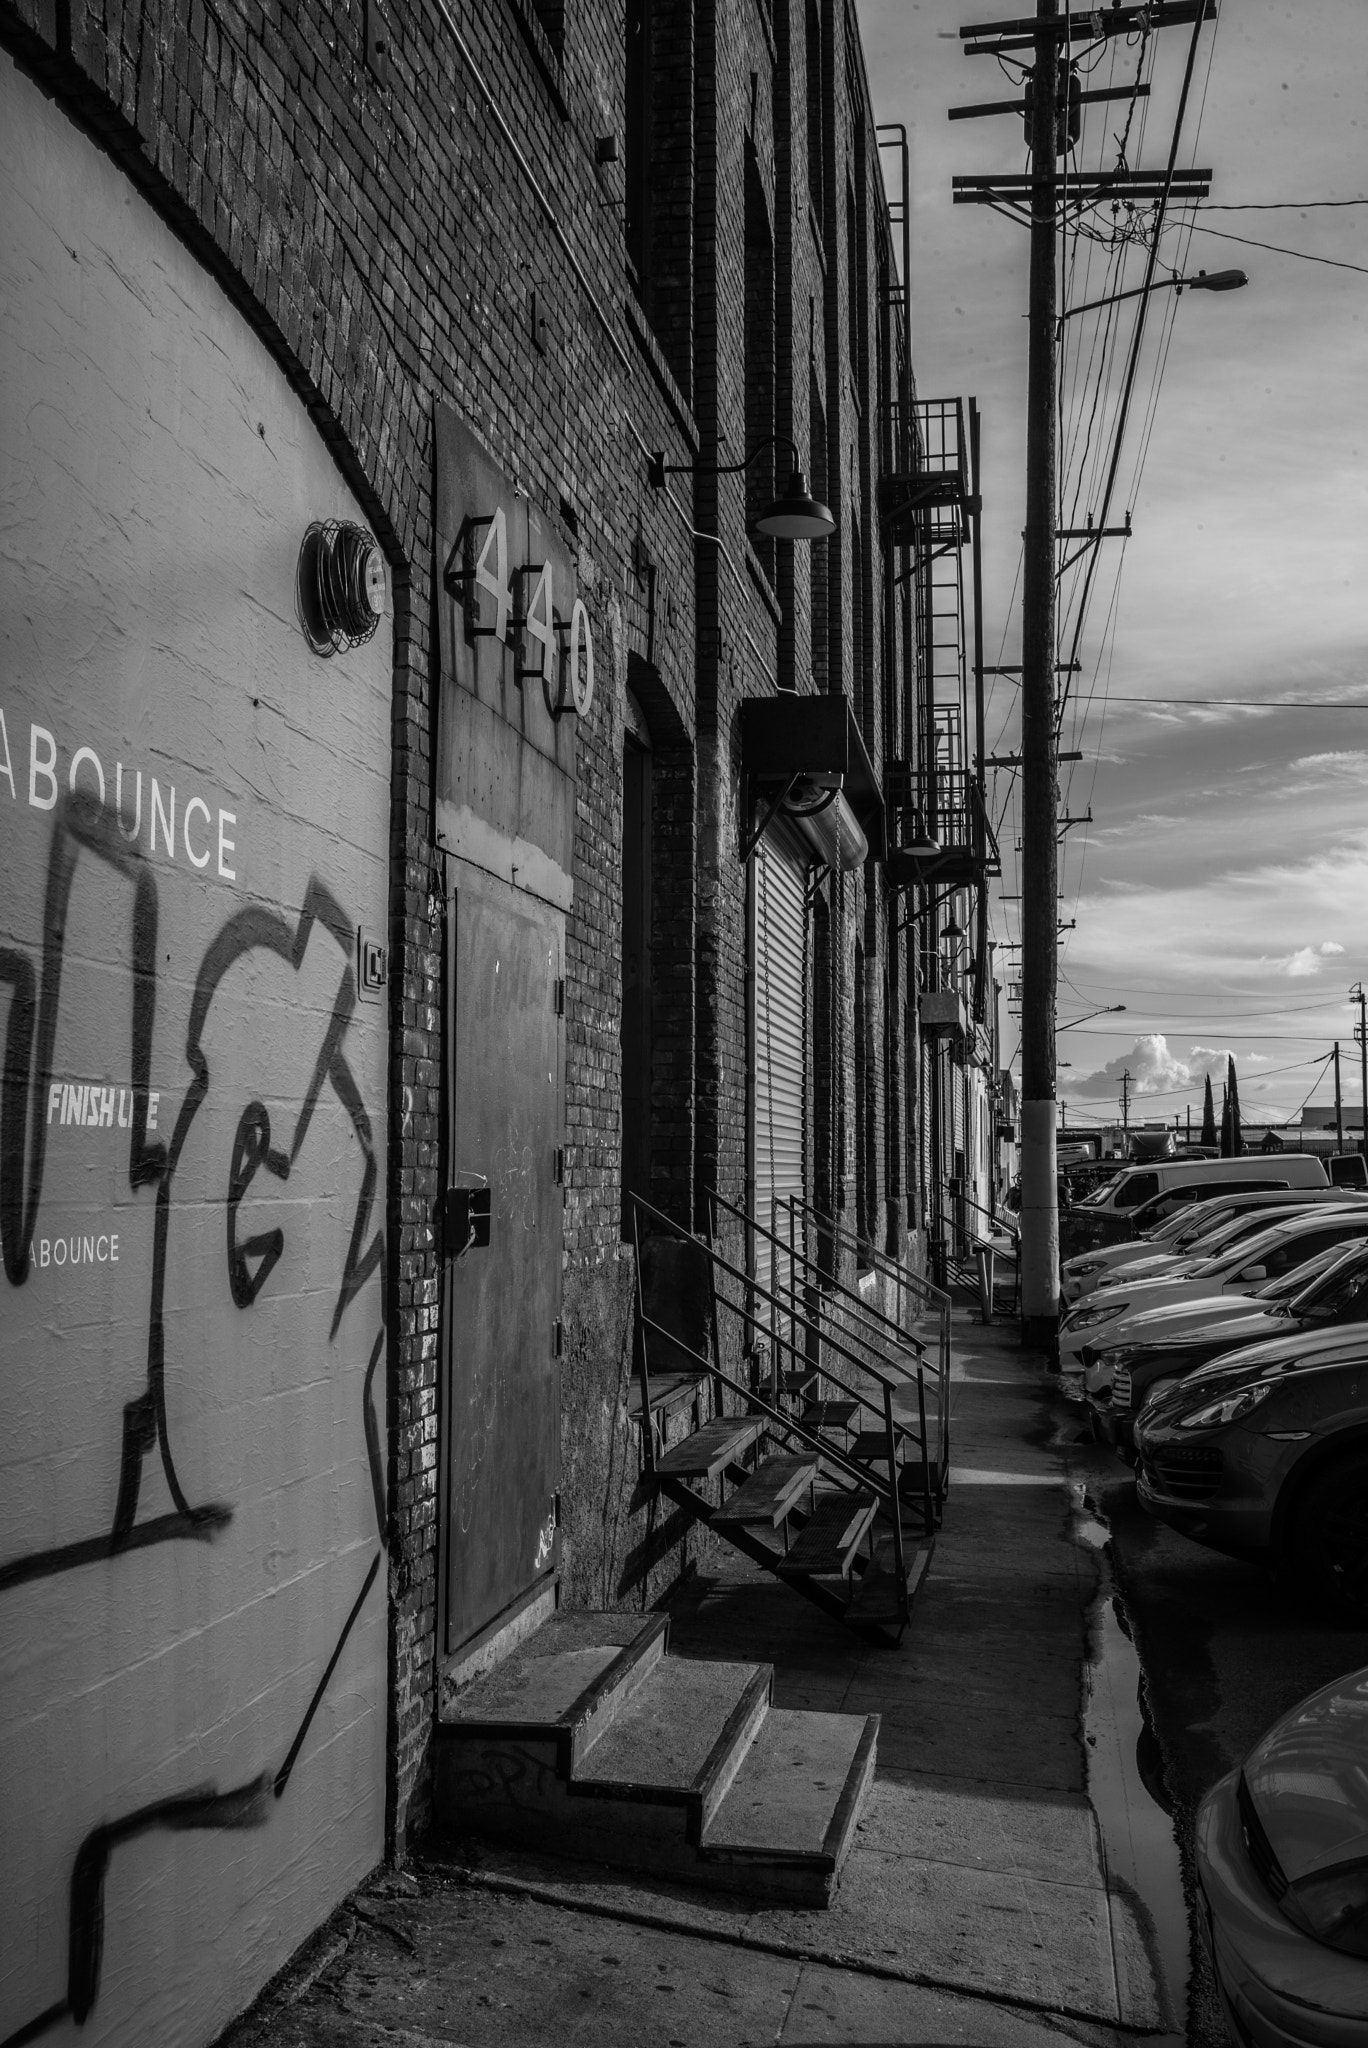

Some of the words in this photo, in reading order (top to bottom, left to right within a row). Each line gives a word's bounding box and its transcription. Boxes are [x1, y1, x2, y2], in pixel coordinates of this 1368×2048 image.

[476, 506, 594, 717] 440
[46, 1083, 115, 1127] FINISH
[117, 1089, 160, 1129] LIE
